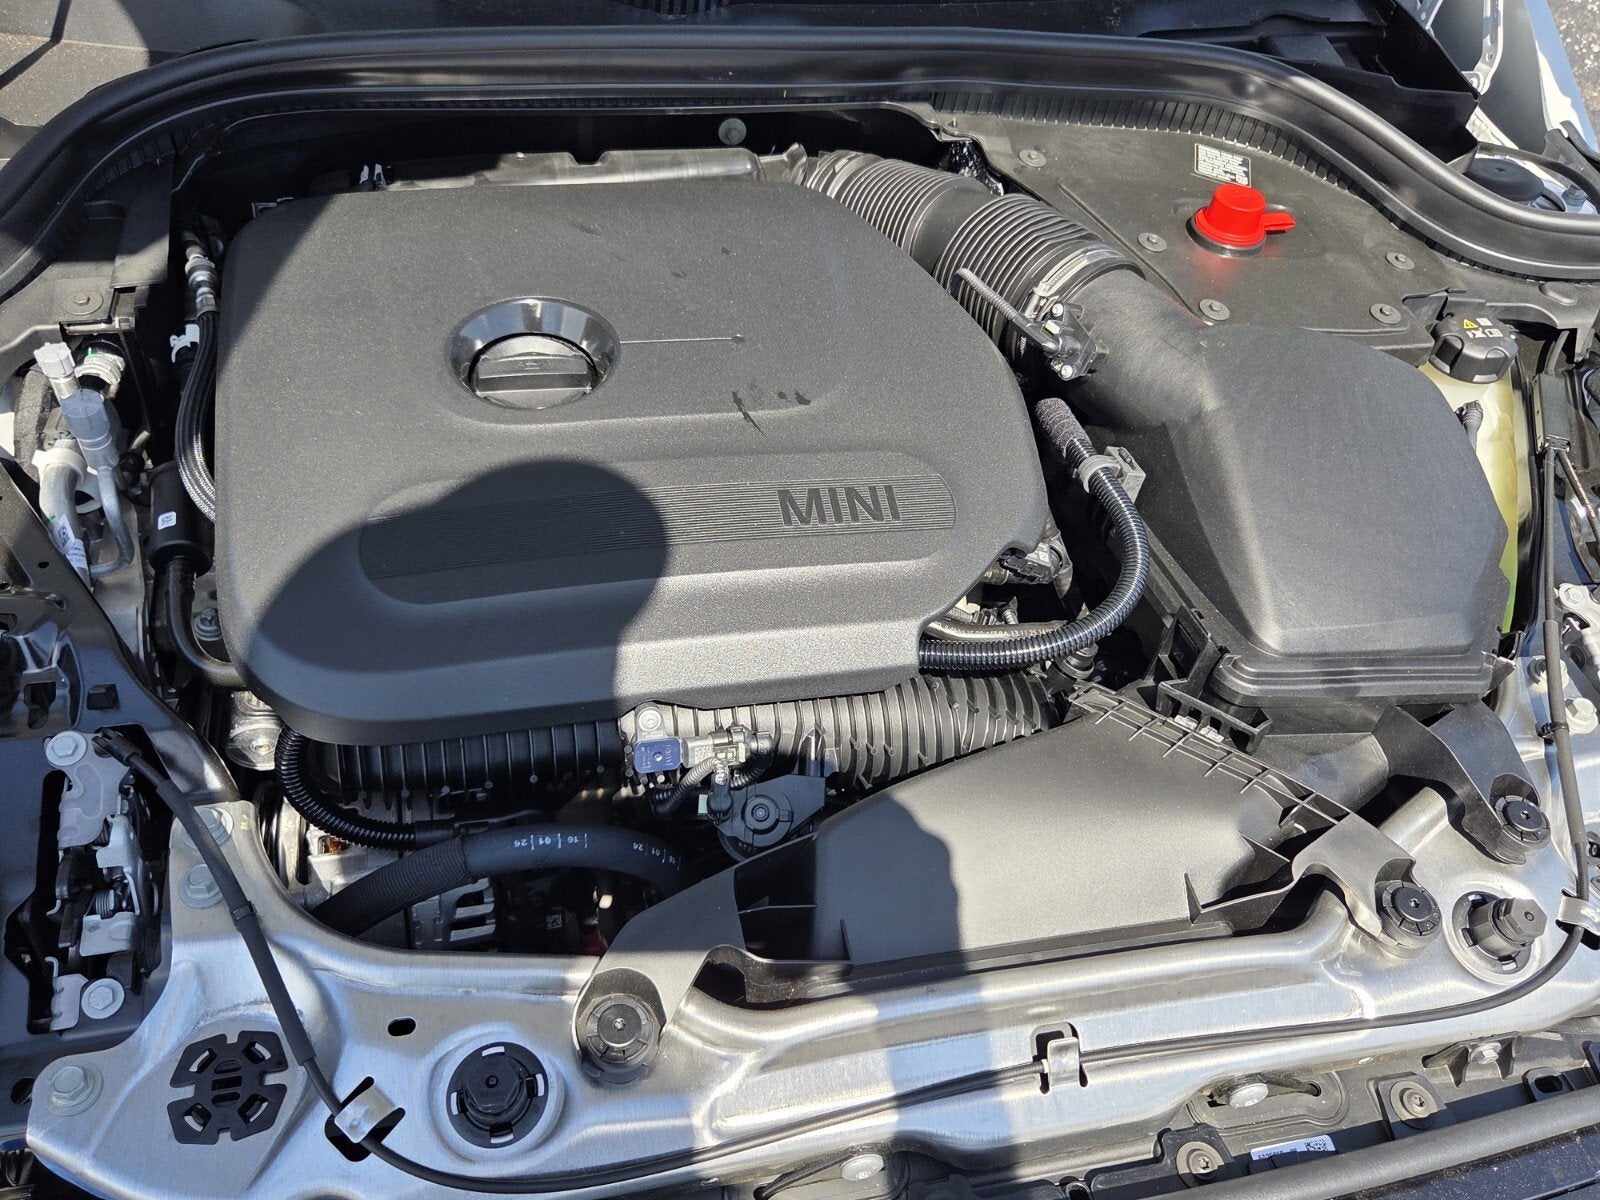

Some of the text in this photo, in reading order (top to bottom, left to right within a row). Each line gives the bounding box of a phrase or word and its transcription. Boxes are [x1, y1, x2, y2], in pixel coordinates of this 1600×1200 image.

[777, 484, 900, 527] MINI
[538, 835, 552, 846] 01
[567, 835, 579, 844] 16
